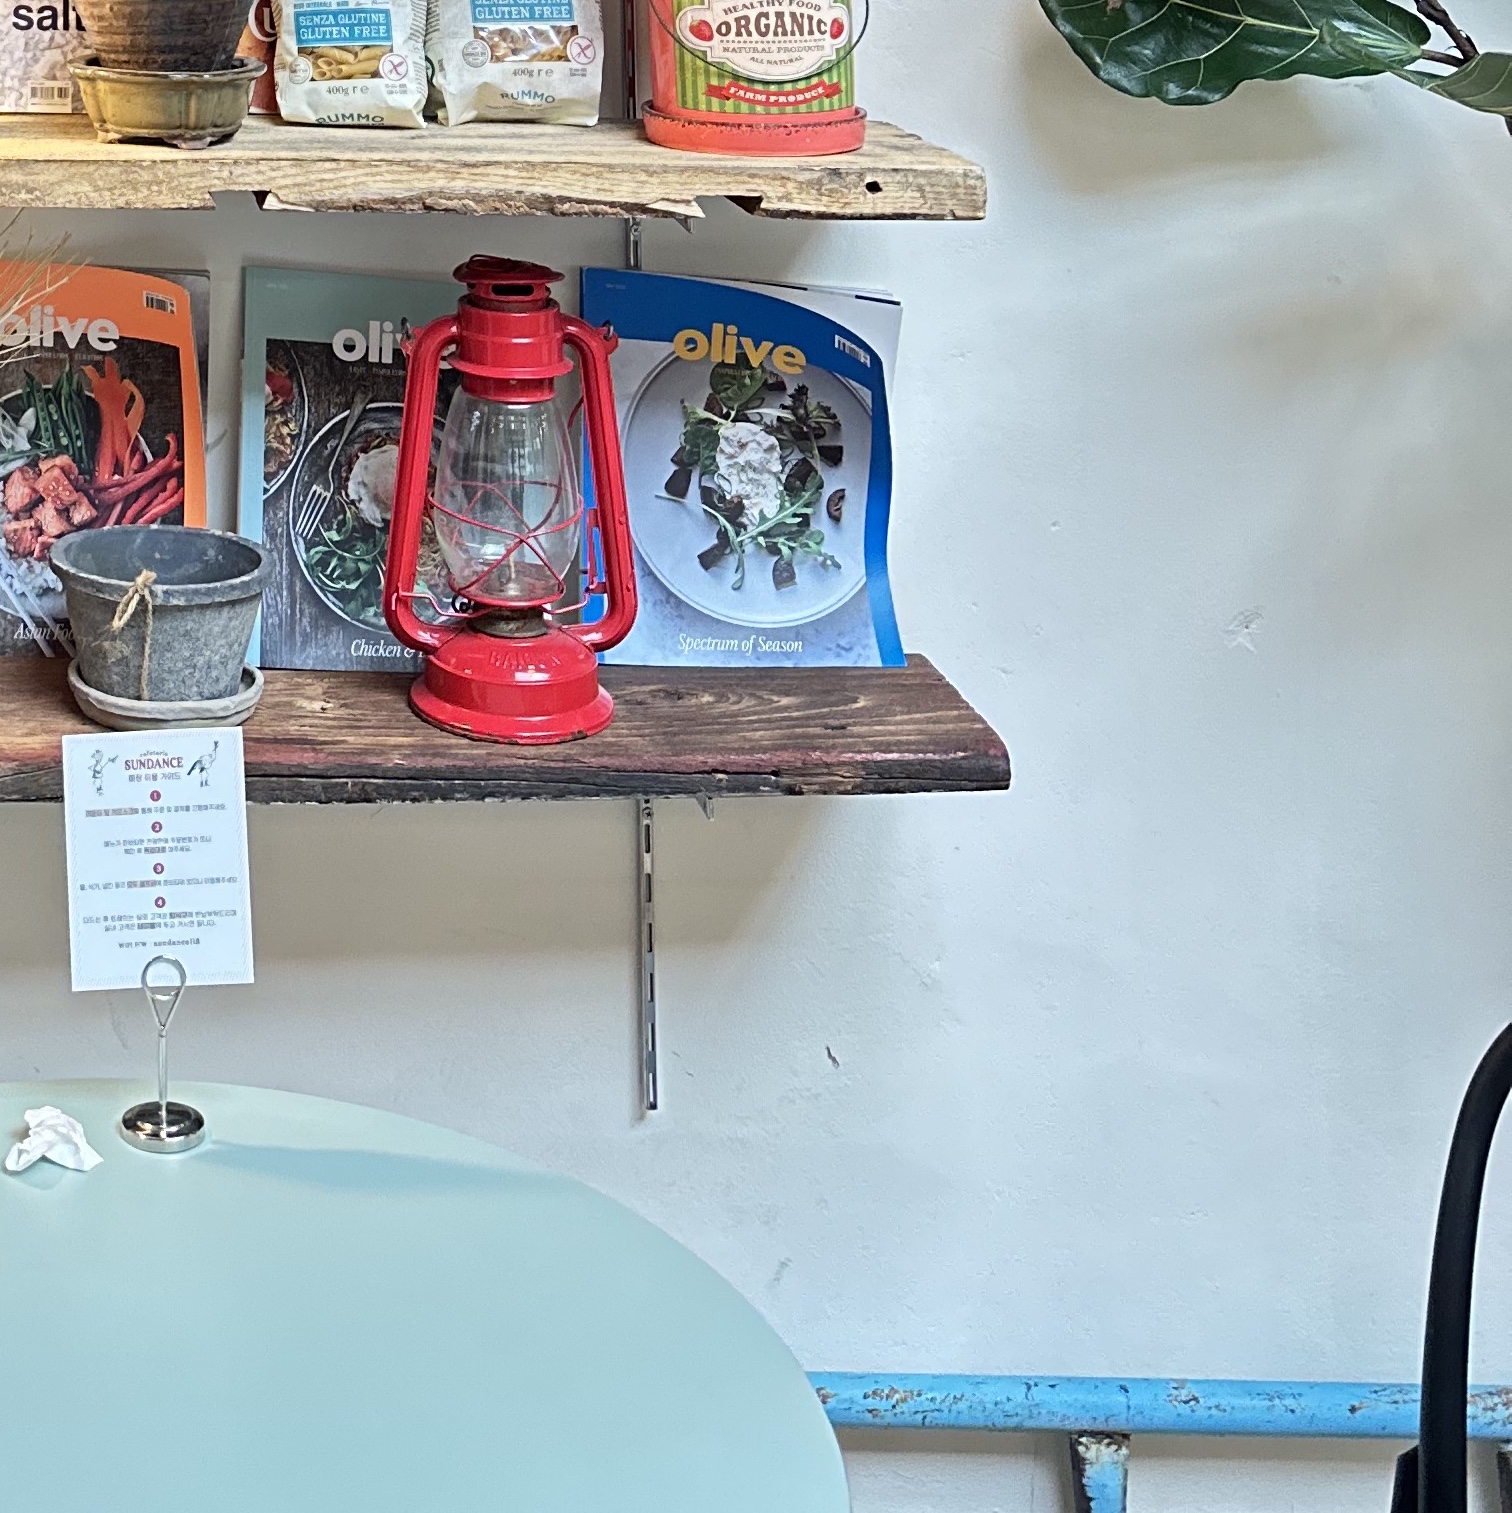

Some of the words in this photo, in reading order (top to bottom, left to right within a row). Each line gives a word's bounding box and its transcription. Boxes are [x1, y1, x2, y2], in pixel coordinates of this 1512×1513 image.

[475, 7, 530, 19] GLUTEN
[534, 6, 570, 18] FREE
[722, 0, 784, 16] HEALTHY
[788, 0, 822, 12] FOOD
[299, 15, 335, 26] SENZA
[338, 13, 387, 24] GLUTINE
[715, 11, 828, 38] ORGANIC
[299, 27, 350, 39] GLUTEN
[354, 26, 388, 37] FREE
[722, 46, 774, 54] NATURAL
[776, 44, 825, 54] PRODUCTS
[749, 55, 765, 64] ALL
[766, 55, 803, 65] NATURAL
[512, 69, 534, 78] 400g
[326, 86, 349, 96] 400g
[500, 89, 555, 104] RUMMO
[728, 86, 767, 103] FARM
[768, 86, 825, 103] PRODUCE
[316, 112, 385, 124] RUMMO
[332, 320, 454, 370] oli
[673, 322, 807, 375] olive
[13, 623, 49, 640] Asian
[350, 639, 401, 658] Chicken
[679, 633, 739, 655] Spectrum
[741, 635, 757, 656] of
[757, 636, 803, 653] Season
[124, 757, 184, 771] SUNDANCE
